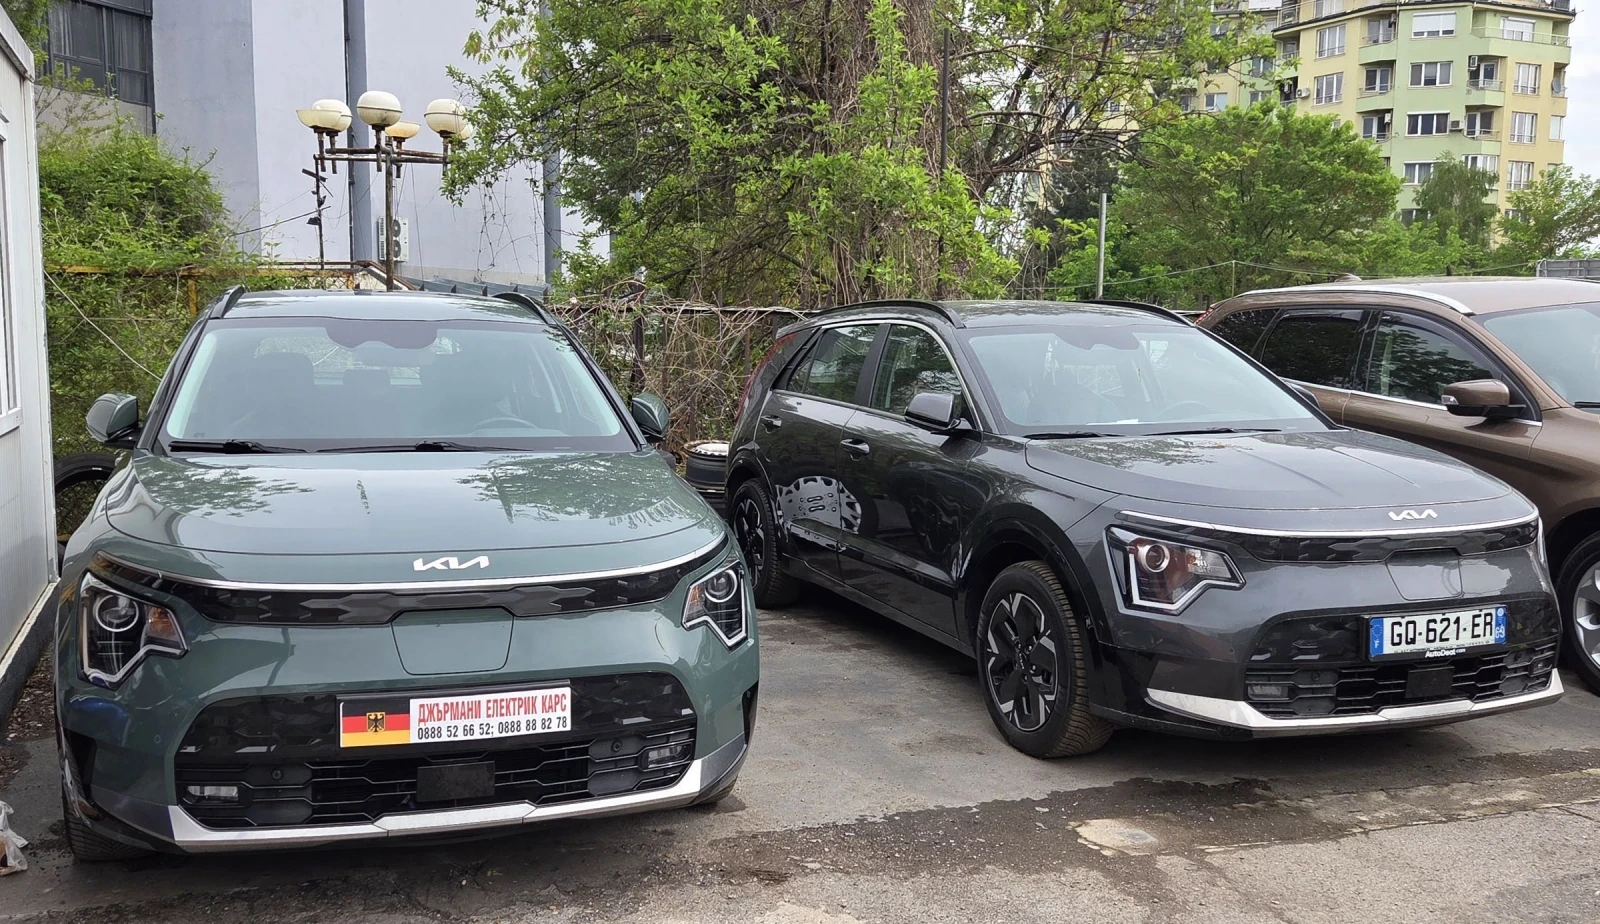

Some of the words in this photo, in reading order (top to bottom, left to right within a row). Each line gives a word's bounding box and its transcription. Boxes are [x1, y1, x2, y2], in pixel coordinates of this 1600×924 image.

[418, 700, 481, 726] ДЖЪРМАНИ
[486, 695, 538, 718] ЕЛЕКТРИК
[541, 693, 567, 714] КАРС
[417, 726, 442, 740] 0888
[446, 725, 459, 738] 52
[462, 724, 475, 737] 66
[479, 722, 494, 737] 52;
[497, 720, 521, 734] 0888
[525, 718, 537, 731] 88
[541, 717, 552, 730] 82
[556, 716, 567, 729] 78
